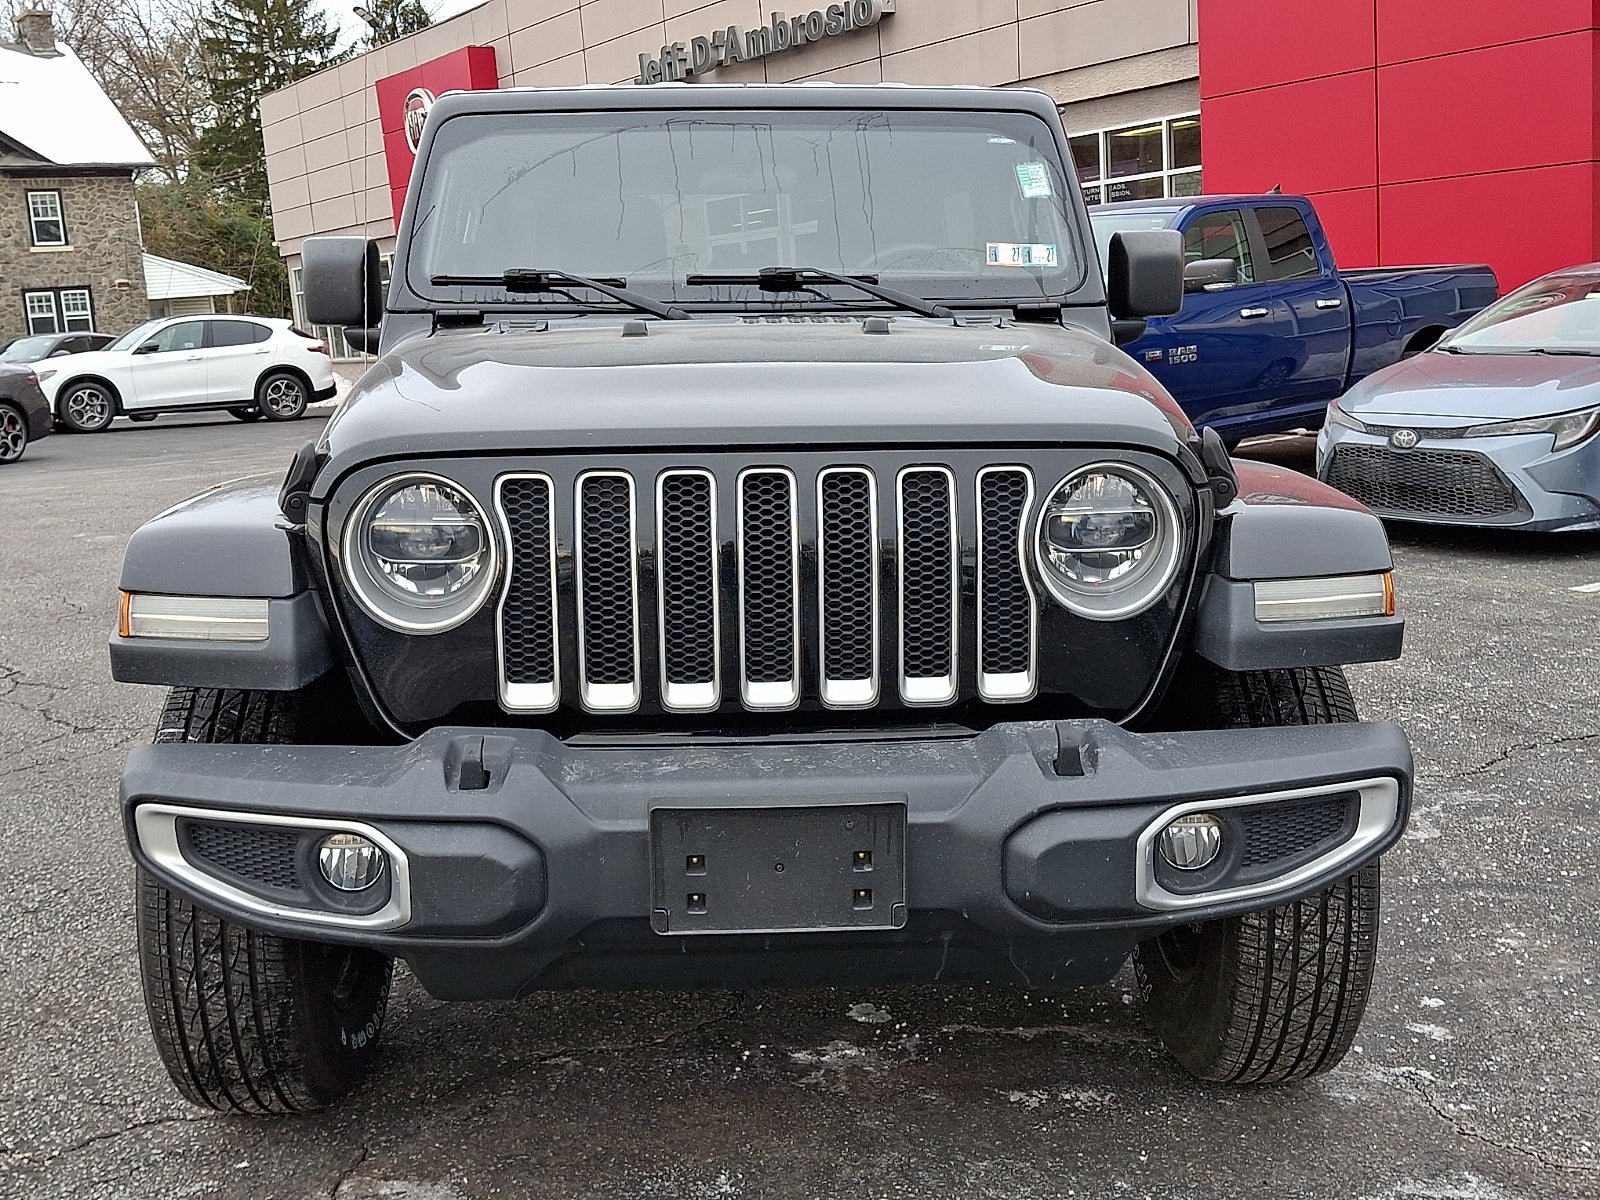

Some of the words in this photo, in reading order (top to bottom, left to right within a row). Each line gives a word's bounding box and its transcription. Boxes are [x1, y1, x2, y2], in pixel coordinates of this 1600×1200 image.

[634, 41, 686, 85] Jeff
[1082, 187, 1100, 195] TURN
[1111, 190, 1132, 198] SSION.
[1168, 345, 1198, 356] RAM
[1169, 353, 1198, 365] 1500
